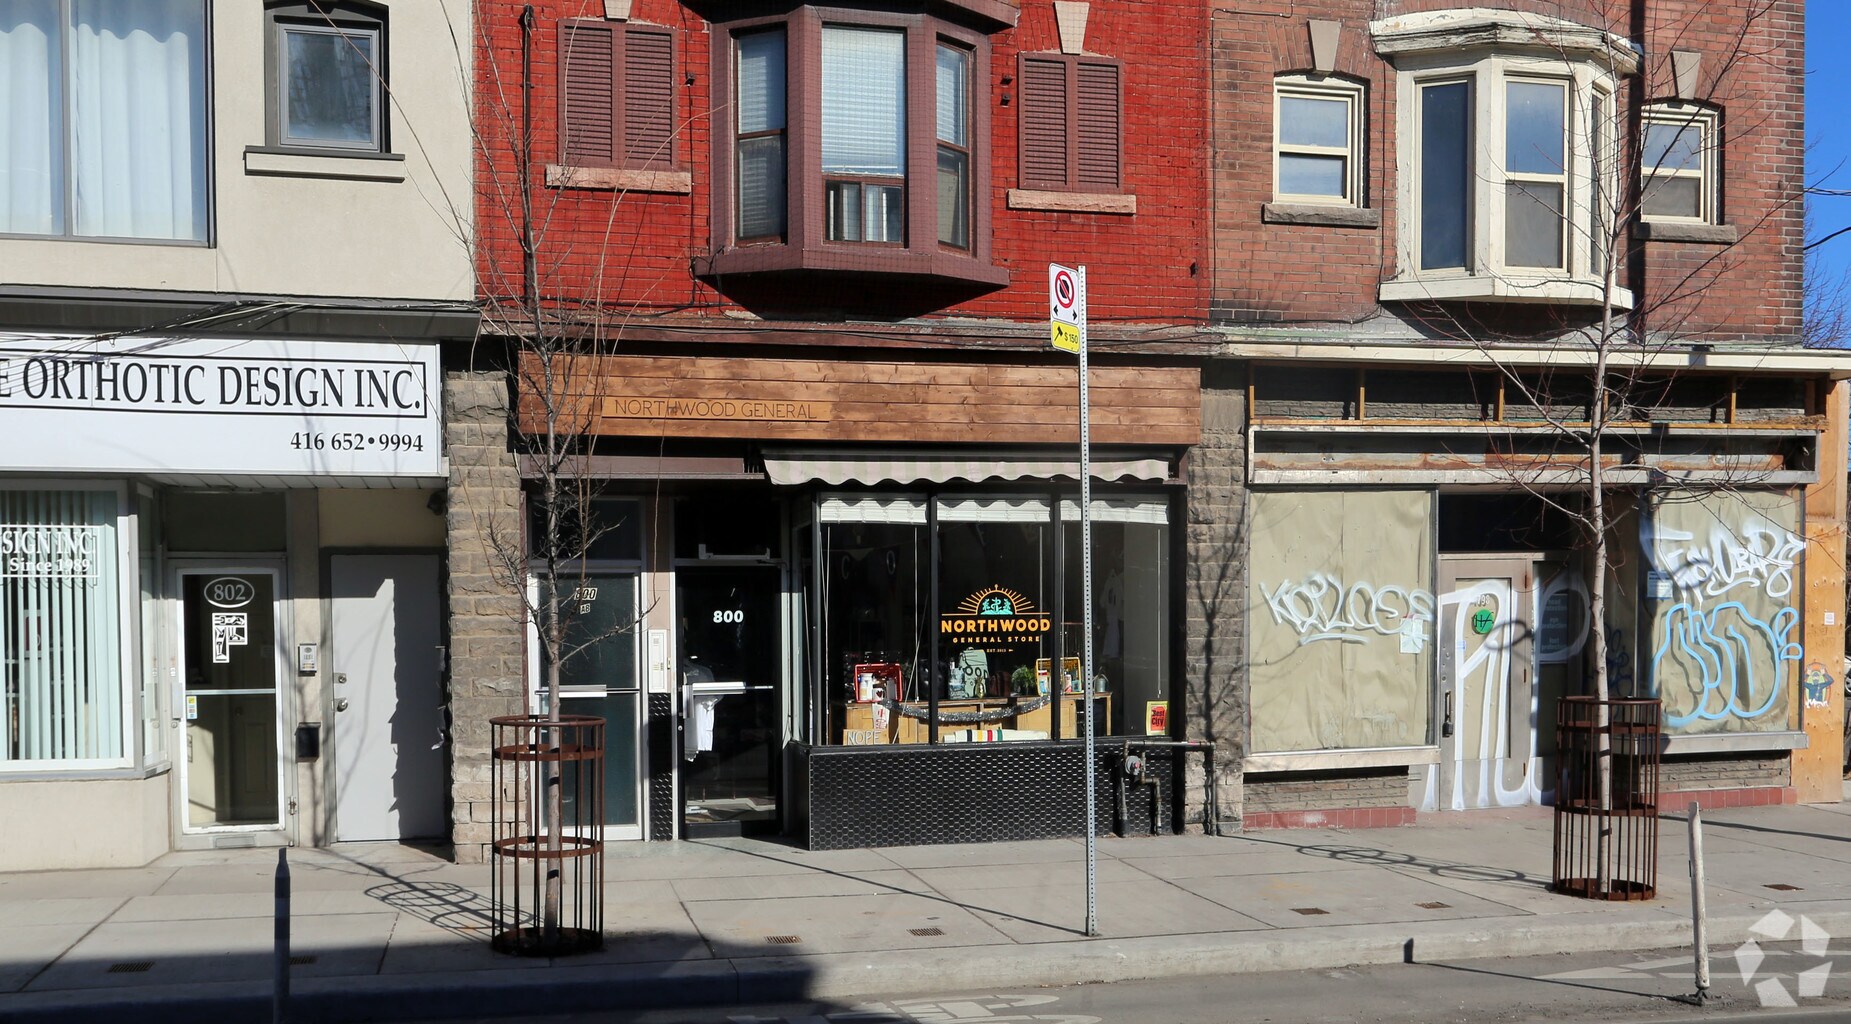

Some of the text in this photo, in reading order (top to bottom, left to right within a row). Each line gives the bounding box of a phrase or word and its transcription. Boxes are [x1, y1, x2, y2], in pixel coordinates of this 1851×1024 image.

[23, 358, 205, 405] ORTHOTIC
[218, 365, 345, 408] DESIGN
[354, 369, 421, 409] INC.
[614, 398, 818, 419] NORTHWOOD GENERAL
[290, 432, 325, 450] 416
[9, 557, 91, 572] Since 1989
[213, 584, 246, 601] 802
[713, 610, 744, 624] 800
[941, 619, 1051, 633] NORTHWOOD
[952, 635, 1041, 644] GENERAL STORE
